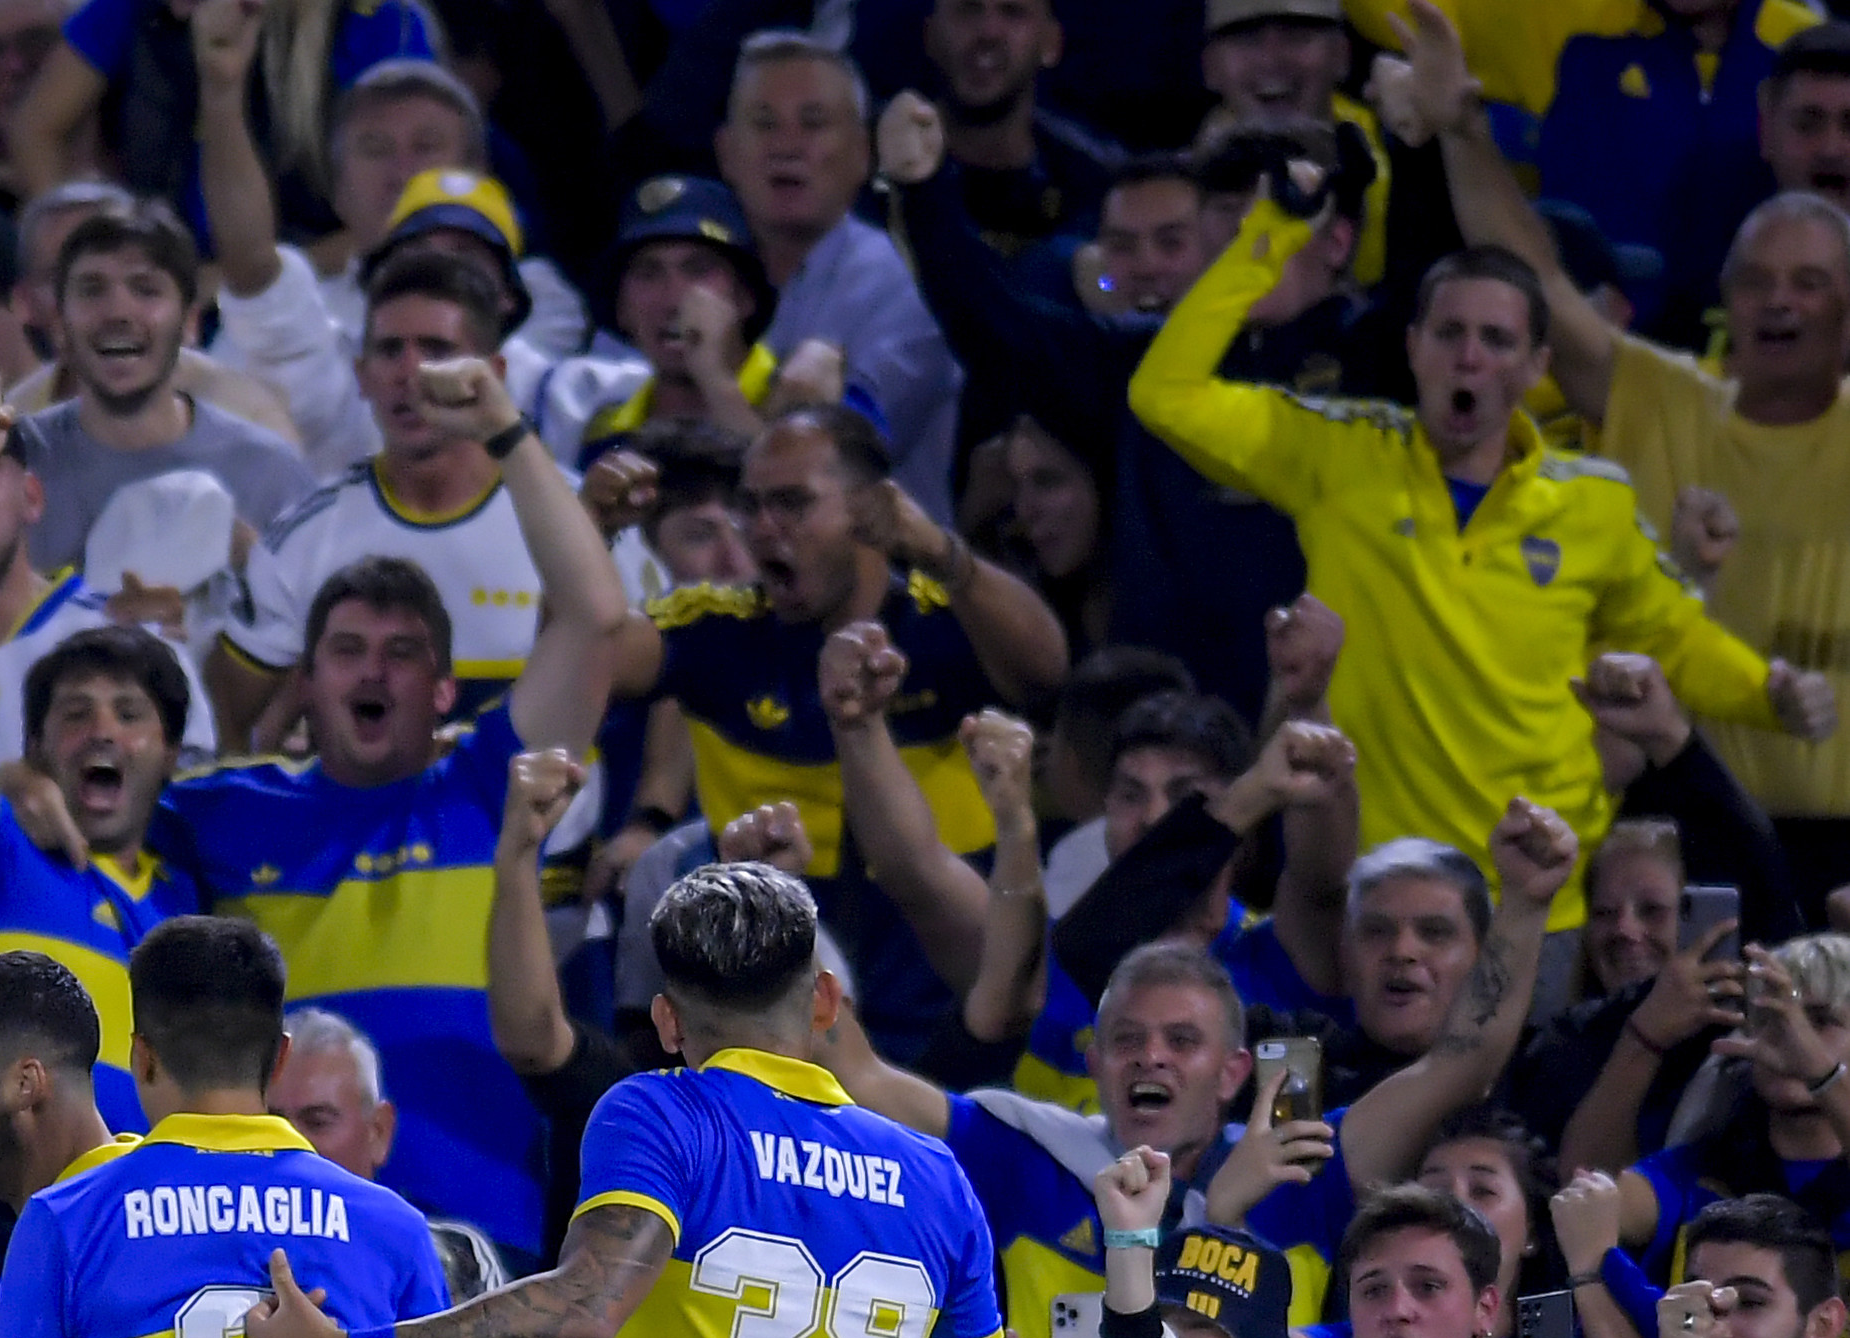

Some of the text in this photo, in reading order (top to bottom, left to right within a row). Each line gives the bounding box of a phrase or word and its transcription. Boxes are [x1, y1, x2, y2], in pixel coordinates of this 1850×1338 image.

[750, 1130, 905, 1208] VAZQUEZ
[124, 1186, 350, 1243] RONCAGLIA
[1178, 1235, 1259, 1294] BOCA
